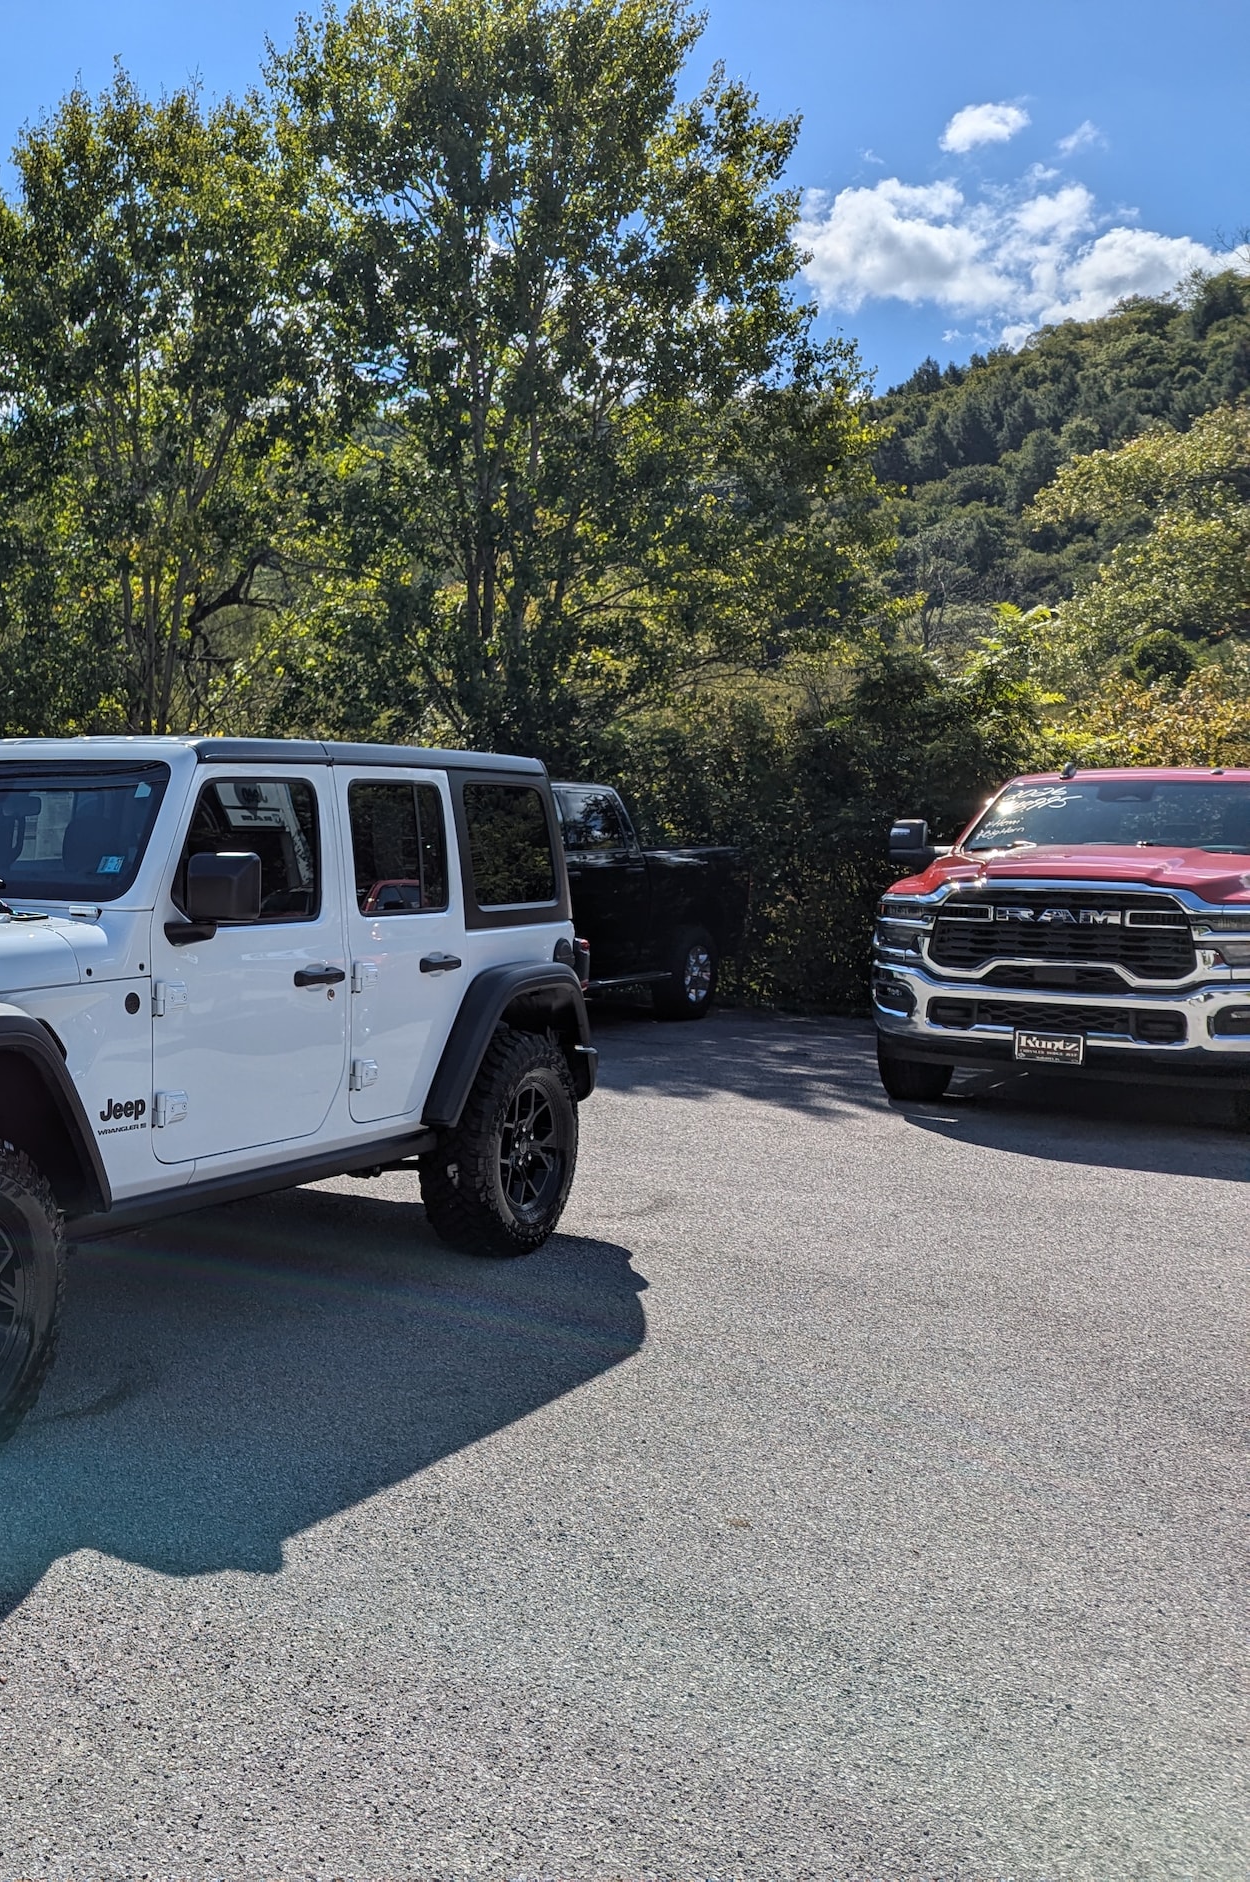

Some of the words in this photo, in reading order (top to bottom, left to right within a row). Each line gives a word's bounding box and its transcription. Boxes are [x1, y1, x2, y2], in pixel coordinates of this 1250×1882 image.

[1002, 786, 1068, 801] 2026
[996, 906, 1121, 924] RAM
[1020, 1035, 1079, 1051] Kuntz
[99, 1098, 146, 1122] Jeep
[97, 1124, 139, 1136] WRANGLER
